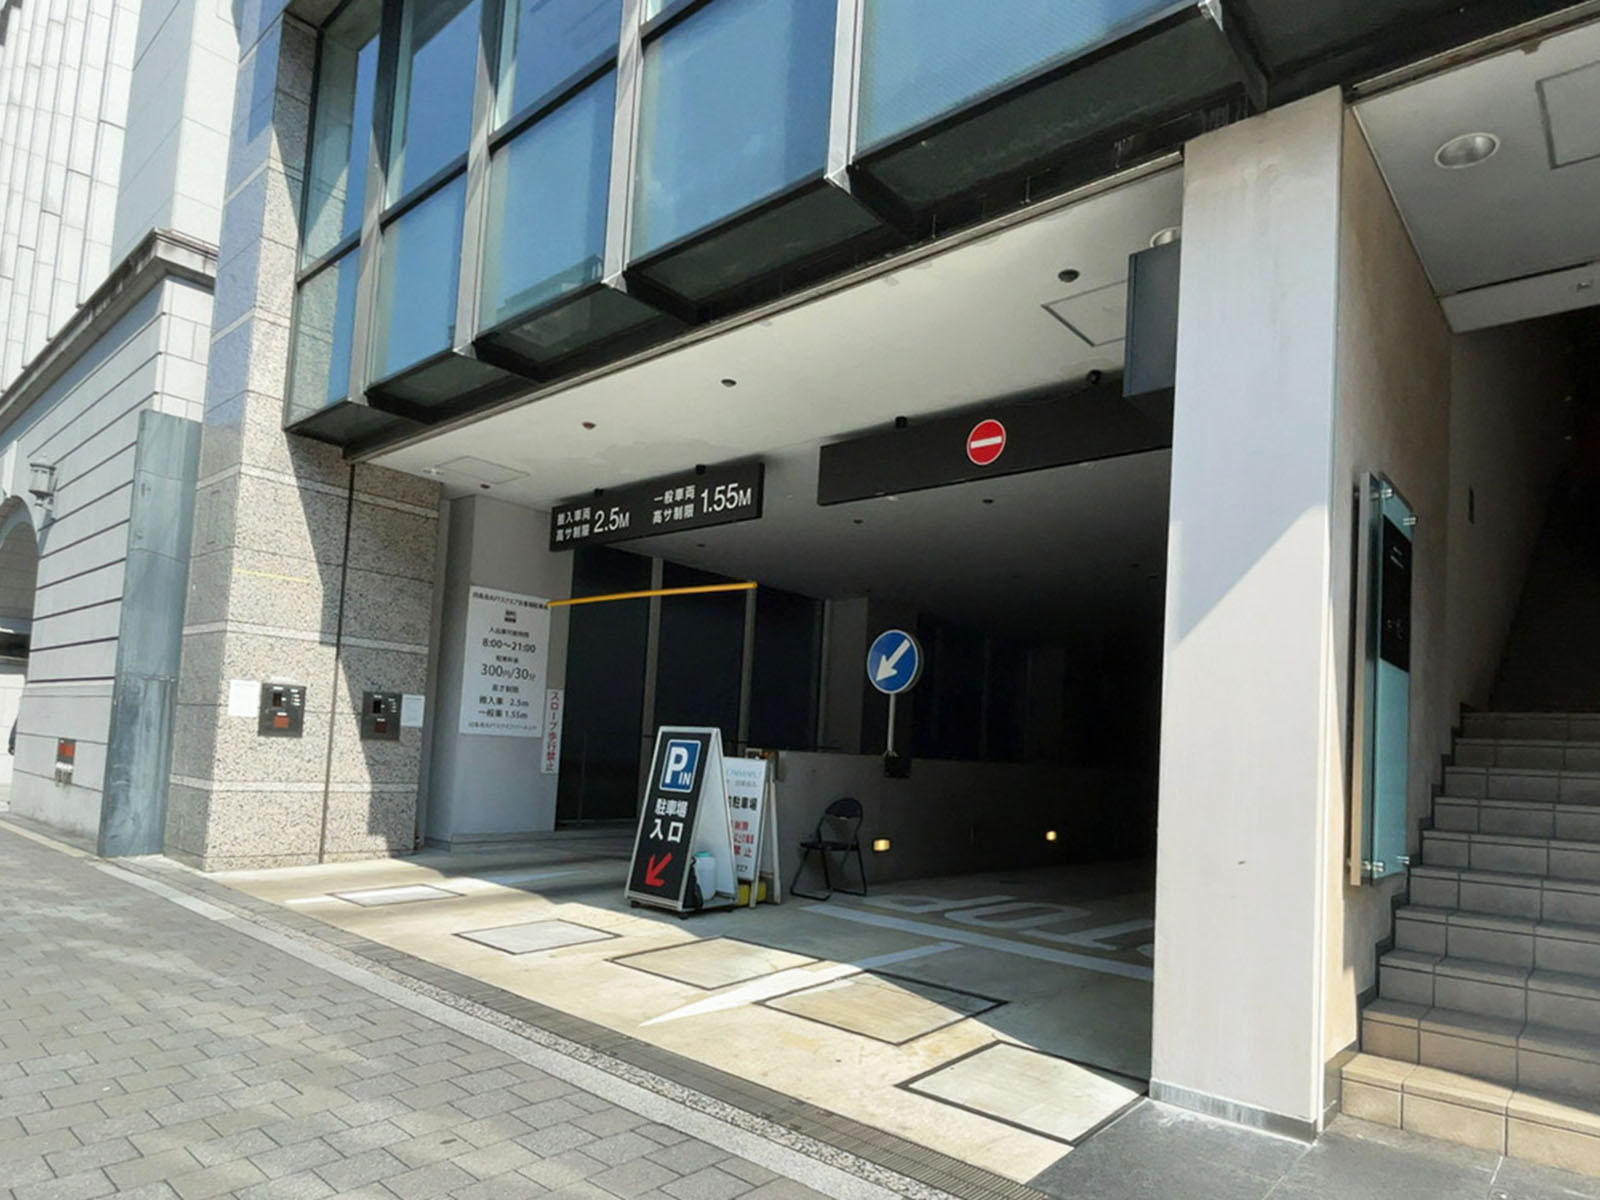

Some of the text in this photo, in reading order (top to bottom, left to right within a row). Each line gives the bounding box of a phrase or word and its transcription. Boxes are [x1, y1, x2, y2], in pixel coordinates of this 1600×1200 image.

[654, 485, 696, 505] 一般車両
[701, 483, 751, 513] 1.55M
[593, 507, 630, 533] 2.5M
[664, 746, 689, 784] P
[678, 772, 692, 786] IN
[654, 798, 688, 818] 駐車場
[649, 819, 684, 844] 入口
